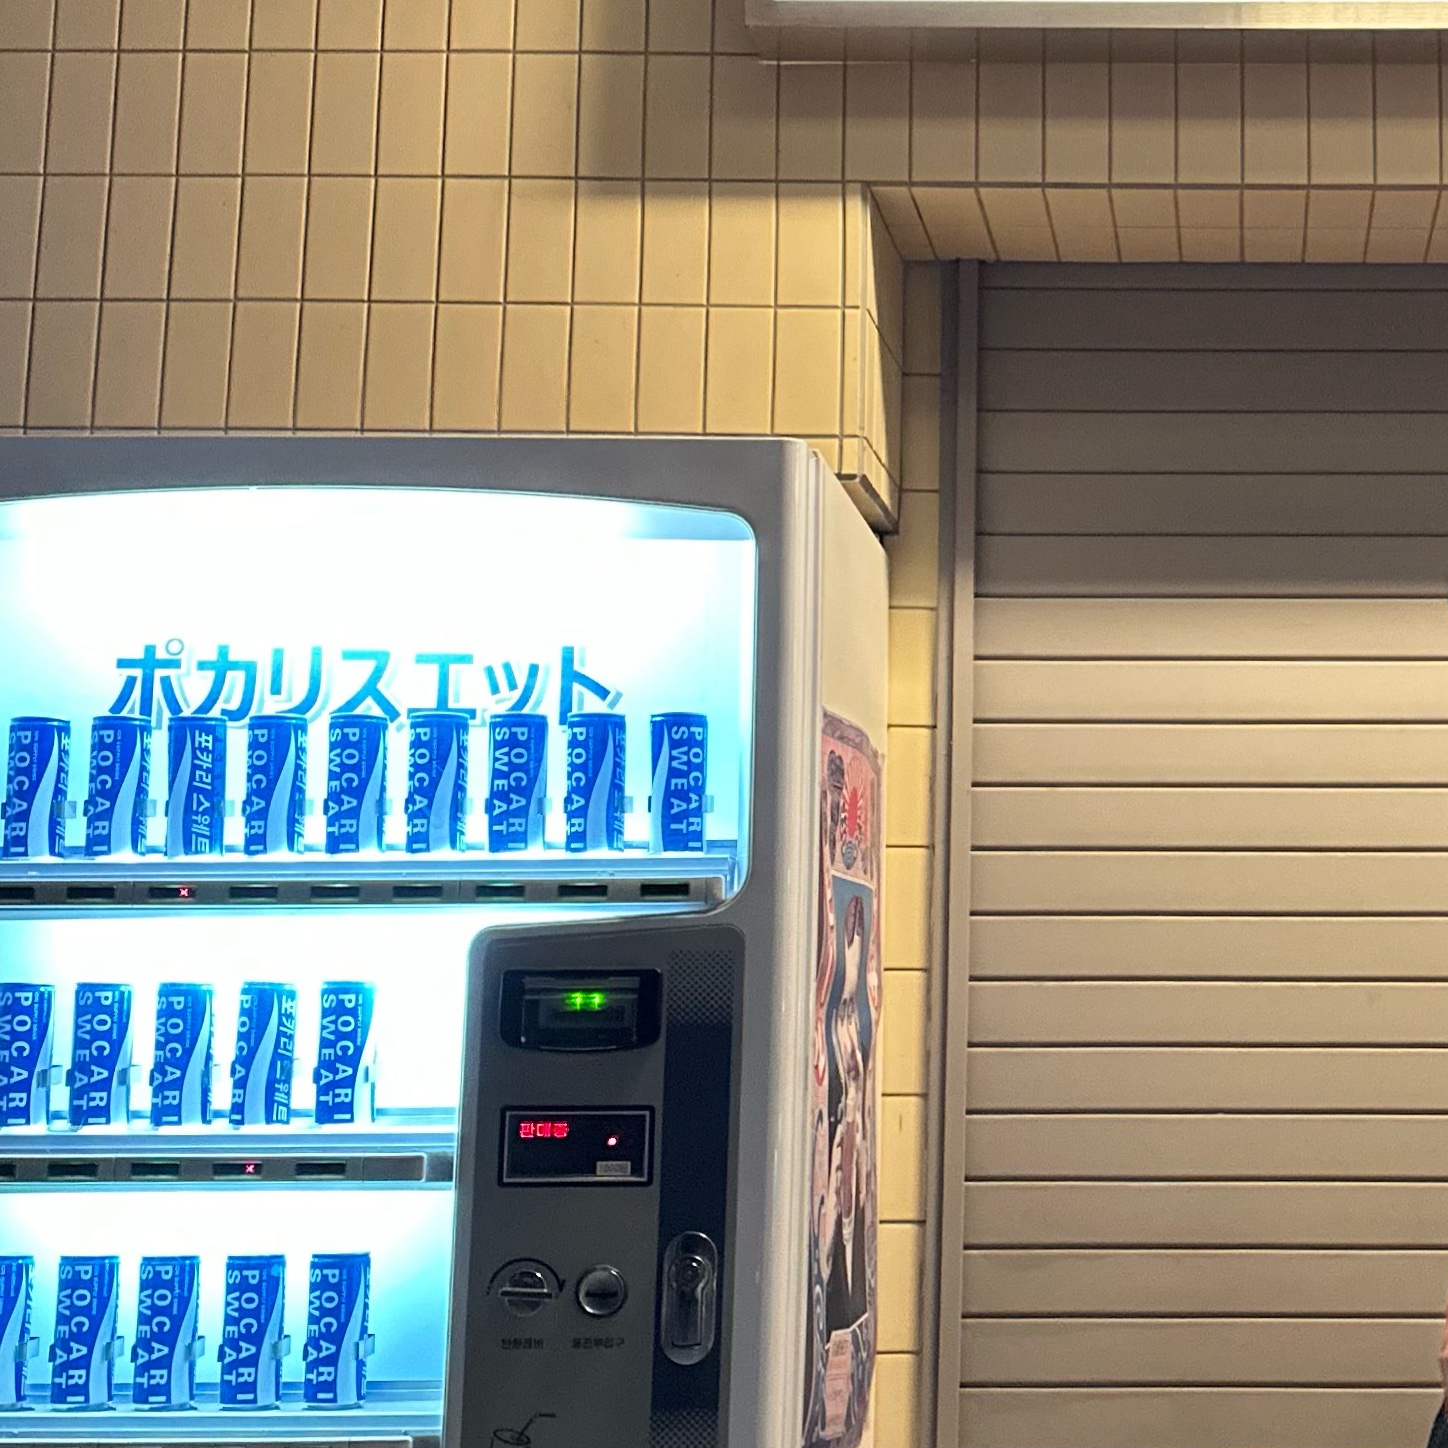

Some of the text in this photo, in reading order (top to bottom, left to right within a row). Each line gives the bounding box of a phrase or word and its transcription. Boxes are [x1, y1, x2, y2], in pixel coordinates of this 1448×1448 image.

[108, 638, 612, 726] ポカリスエット
[10, 730, 32, 853] POCARI
[92, 729, 115, 852] POCARI
[191, 729, 213, 853] 포카리스웨트
[249, 728, 268, 851] POCARI
[326, 727, 342, 836] SWEAT
[338, 727, 360, 850] POCARI
[412, 727, 431, 849] POCARI
[492, 726, 510, 835] SWEAT
[507, 726, 529, 849] POCARI
[570, 726, 587, 849] POCARI
[670, 726, 688, 834] SWEAT
[687, 726, 704, 848] POCARI
[7, 991, 33, 1124] POCARI
[72, 991, 93, 1110] SWEAT
[88, 991, 113, 1124] POCARI
[151, 996, 167, 1108] SWEAT
[162, 996, 185, 1121] POCARI
[230, 994, 252, 1121] POCARI
[319, 993, 336, 1106] SWEAT
[333, 993, 357, 1120] POCARI
[54, 1265, 73, 1389] SWEAT
[67, 1265, 93, 1403] POCARI
[136, 1265, 154, 1389] SWEAT
[148, 1265, 173, 1403] POCARI
[223, 1269, 241, 1386] SWEAT
[236, 1269, 260, 1400] POCARI
[306, 1268, 321, 1385] SWEAT
[317, 1268, 340, 1399] POCARI
